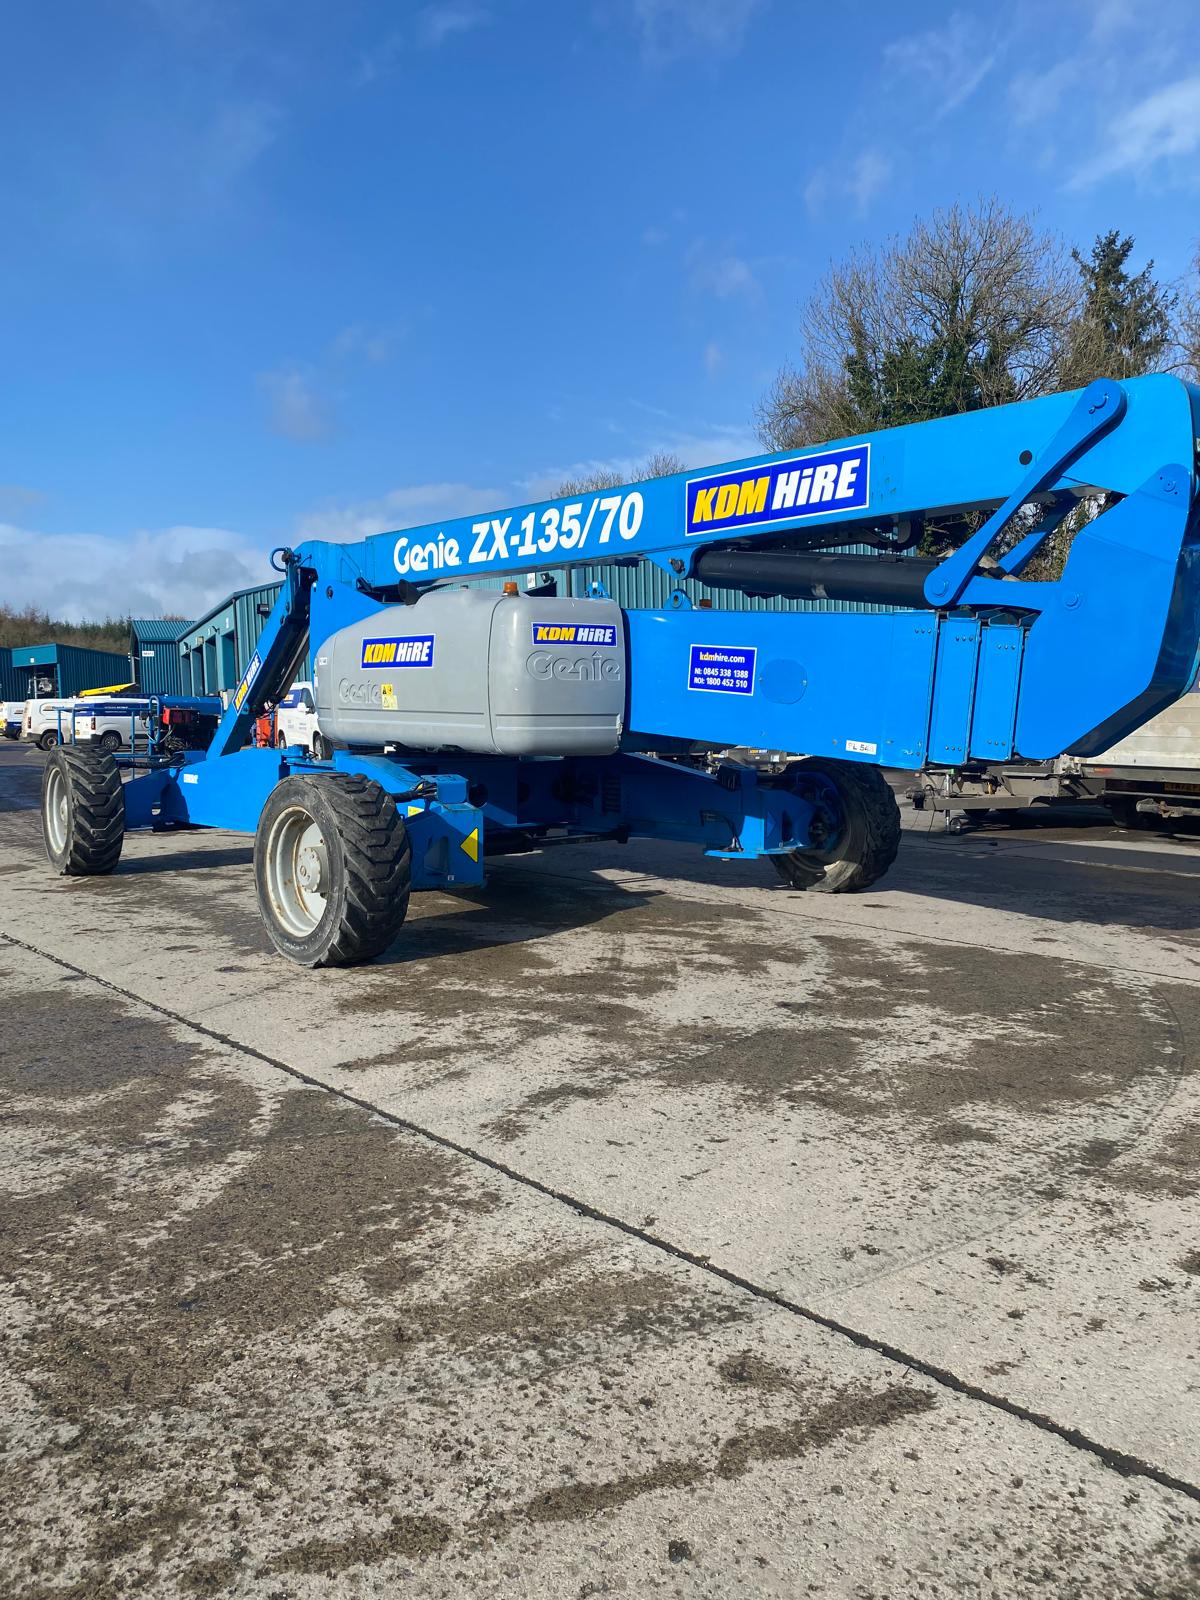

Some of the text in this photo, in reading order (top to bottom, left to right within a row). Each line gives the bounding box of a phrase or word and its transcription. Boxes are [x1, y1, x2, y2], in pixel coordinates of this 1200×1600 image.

[692, 476, 770, 524] KDM
[393, 491, 645, 574] Genie ZX-135/70
[536, 626, 576, 641] KDM
[363, 643, 397, 663] KDM
[699, 651, 745, 663] kdmhire.com
[525, 650, 621, 681] Genie
[703, 667, 719, 676] 0845
[719, 669, 732, 677] 338
[733, 670, 749, 678] 1388
[706, 677, 720, 686] 1800
[721, 679, 734, 687] 452
[735, 680, 748, 688] 510
